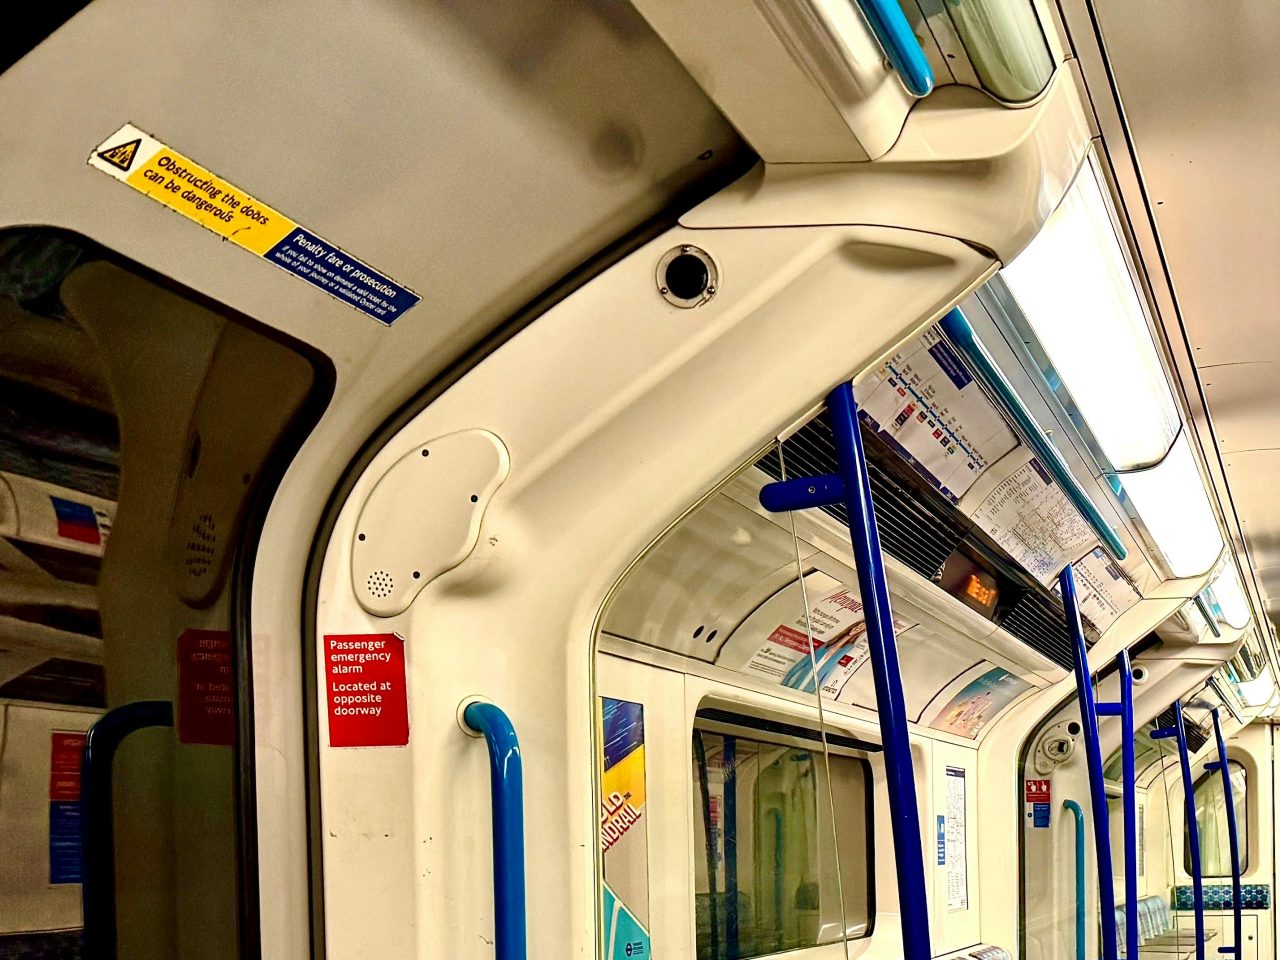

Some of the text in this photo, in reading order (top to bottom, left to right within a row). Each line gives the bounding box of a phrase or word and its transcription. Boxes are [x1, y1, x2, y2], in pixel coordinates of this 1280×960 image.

[143, 169, 234, 223] can be dangerous
[157, 156, 269, 225] Obstructing the doors
[293, 233, 397, 298] Penalty fare or prosecution
[330, 640, 386, 651] Passenger
[330, 652, 391, 663] emergency
[332, 664, 363, 674] alarm
[332, 681, 391, 691] Located at
[333, 693, 382, 705] opposite
[334, 706, 382, 717] doorway
